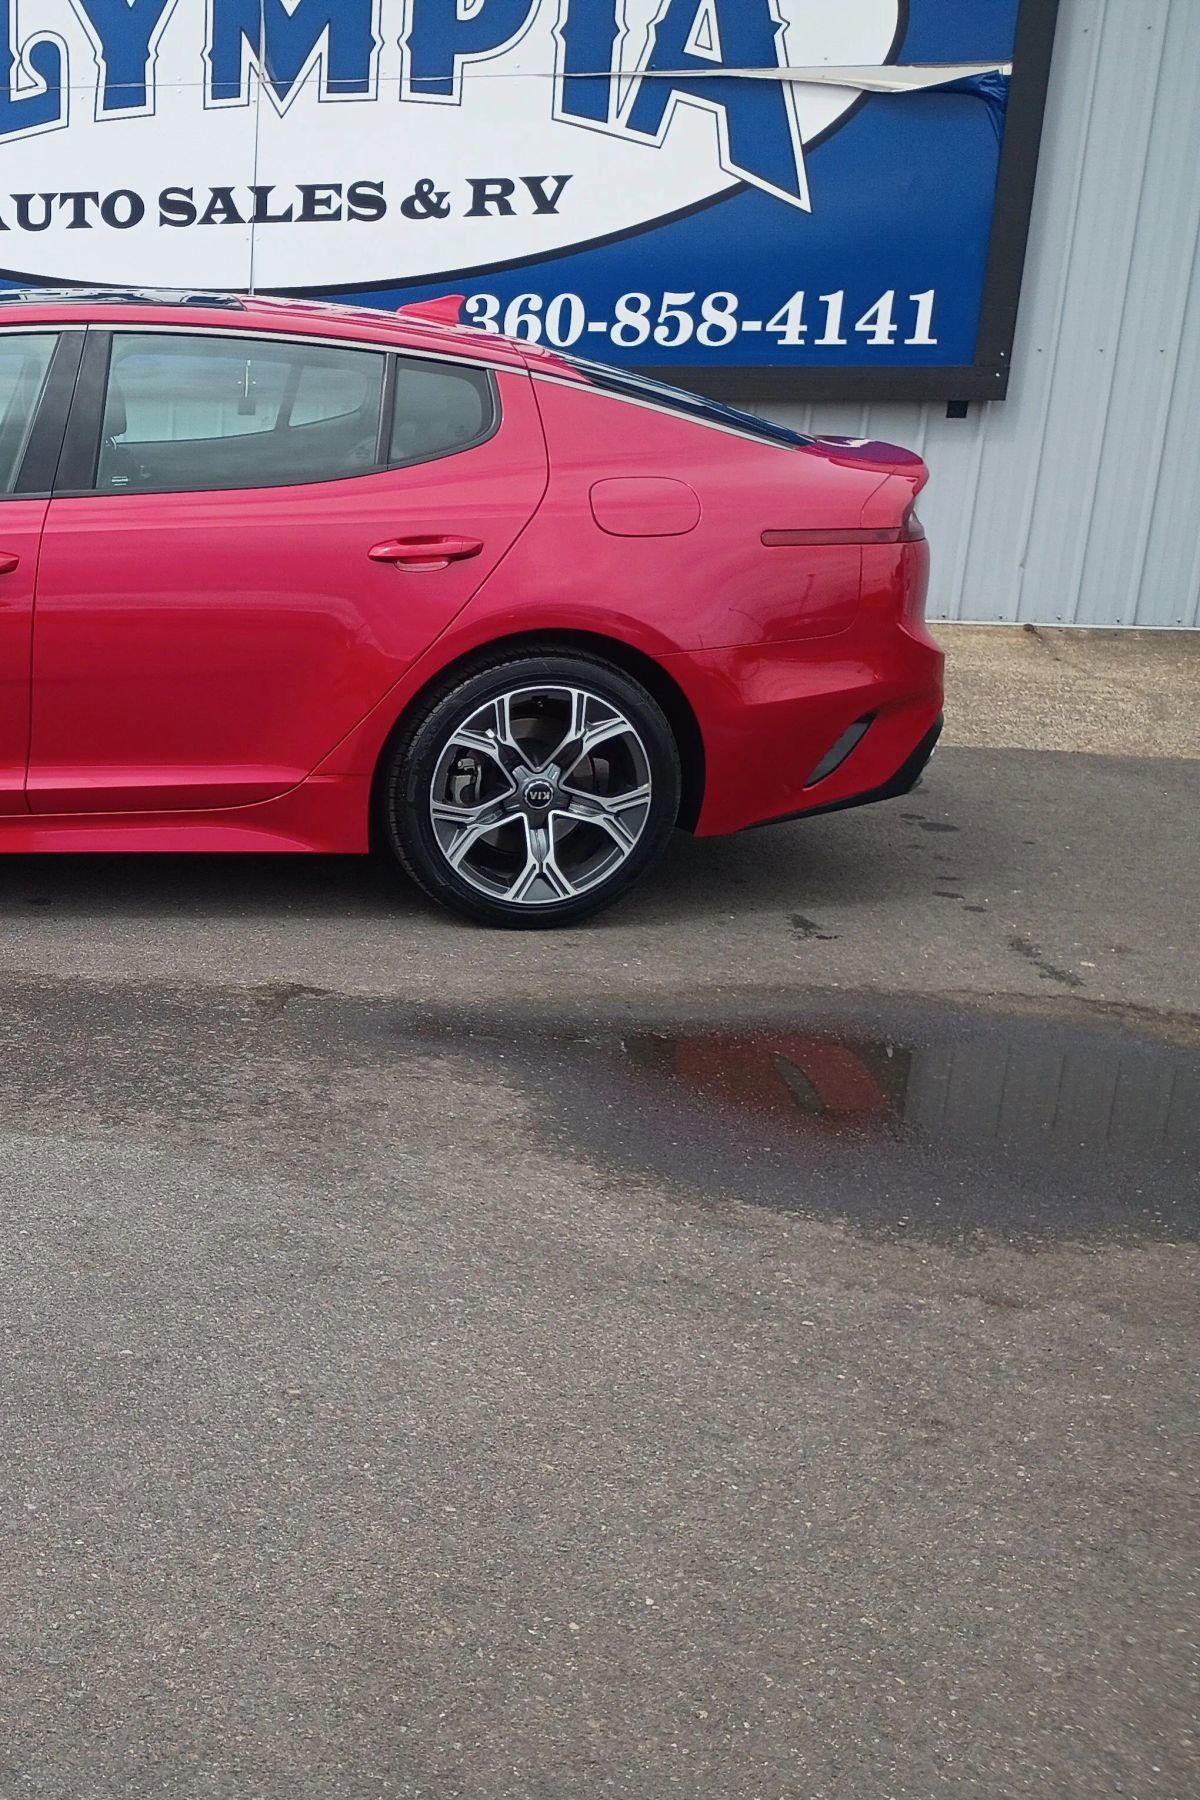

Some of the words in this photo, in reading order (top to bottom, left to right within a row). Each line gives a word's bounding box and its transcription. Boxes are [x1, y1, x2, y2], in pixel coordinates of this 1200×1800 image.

[158, 180, 387, 228] SALES
[400, 178, 451, 220] &
[463, 174, 574, 217] RV
[465, 289, 938, 347] 360-858-4141
